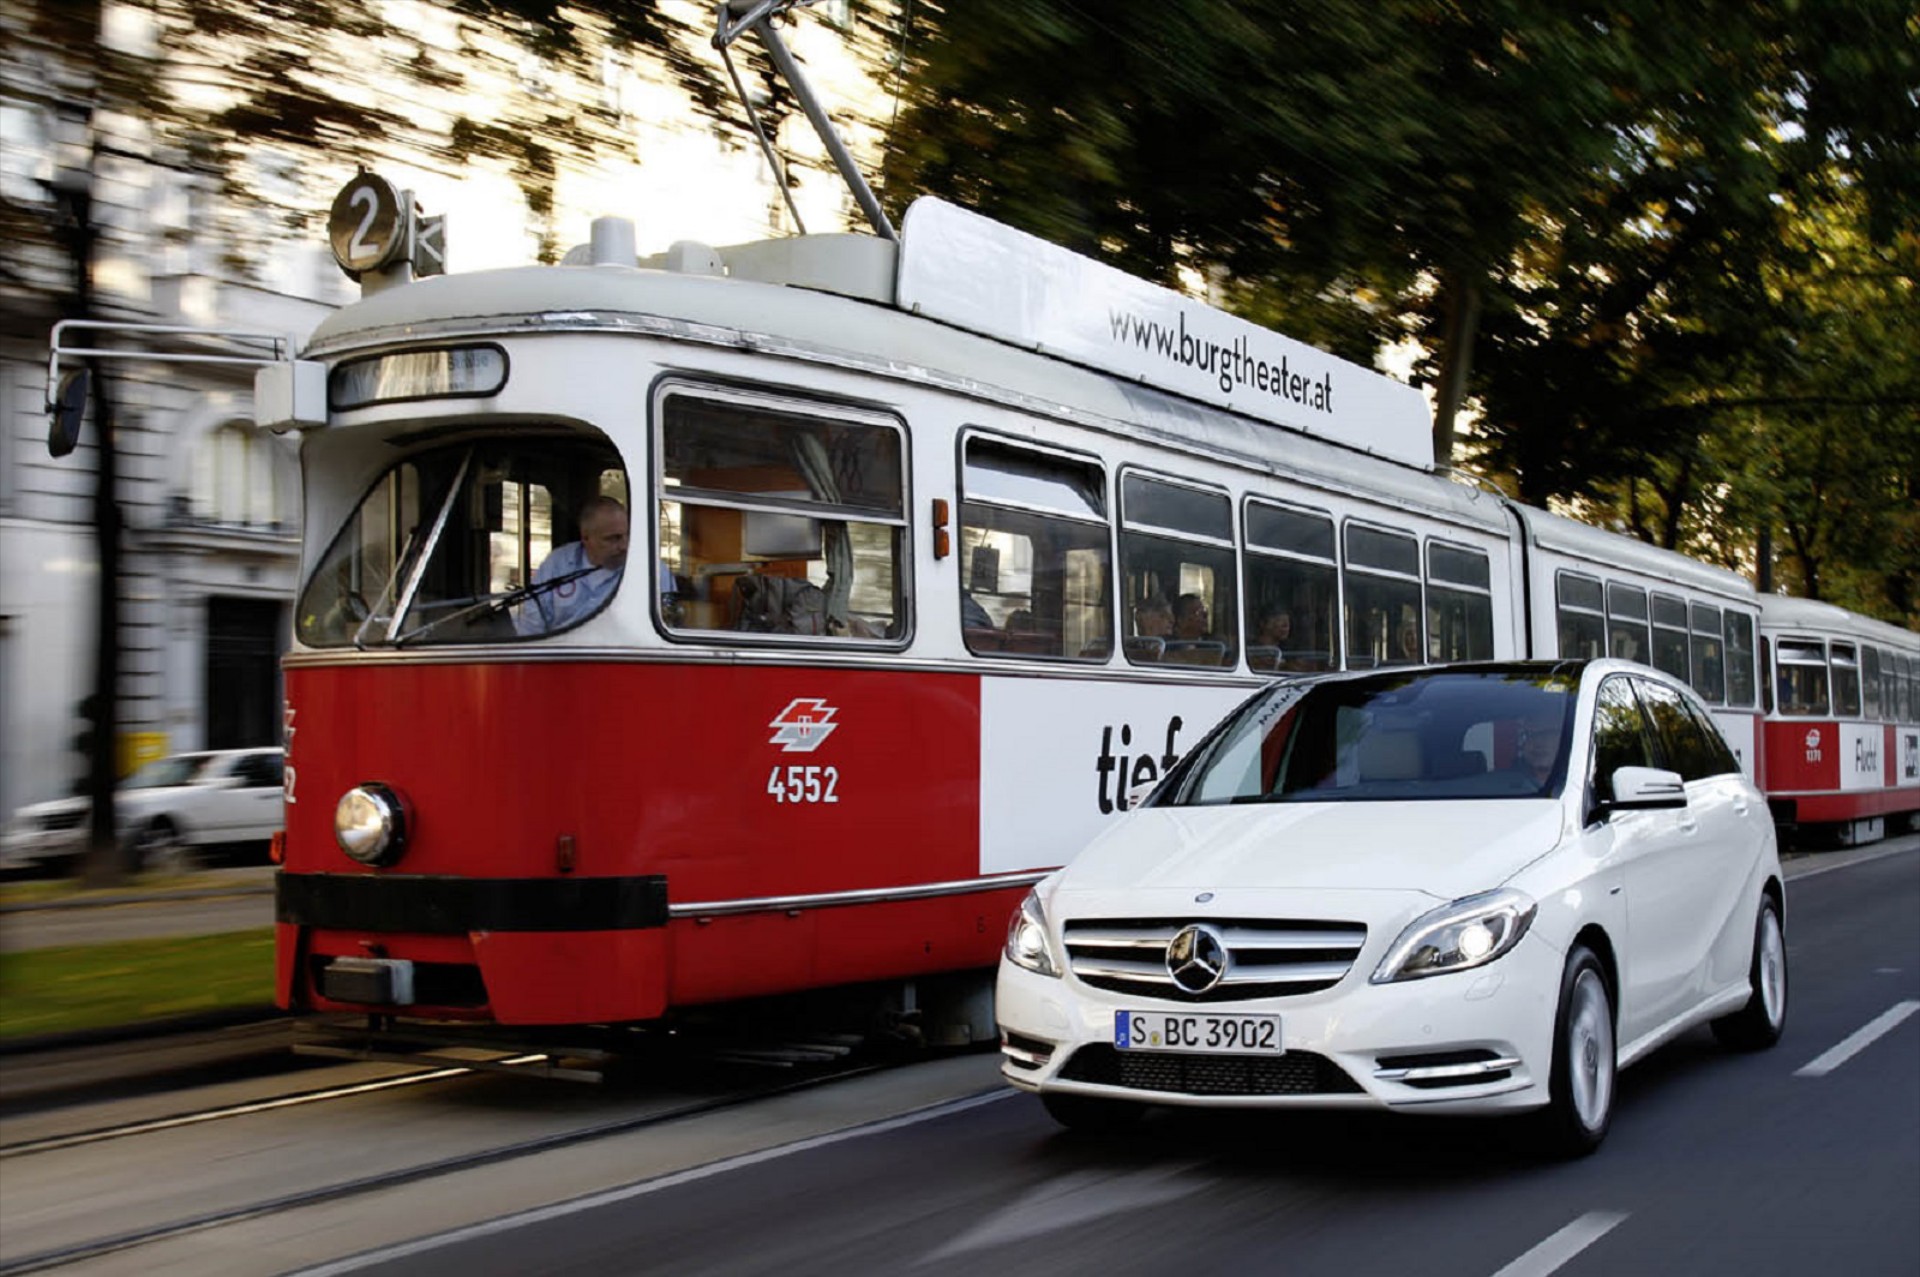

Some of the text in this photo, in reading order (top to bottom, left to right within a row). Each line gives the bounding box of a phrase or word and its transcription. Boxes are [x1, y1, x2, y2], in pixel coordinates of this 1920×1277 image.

[349, 186, 379, 260] 2
[1109, 307, 1333, 413] www.burgtheater.at
[767, 766, 839, 803] 4552
[1206, 1019, 1275, 1048] 3902
